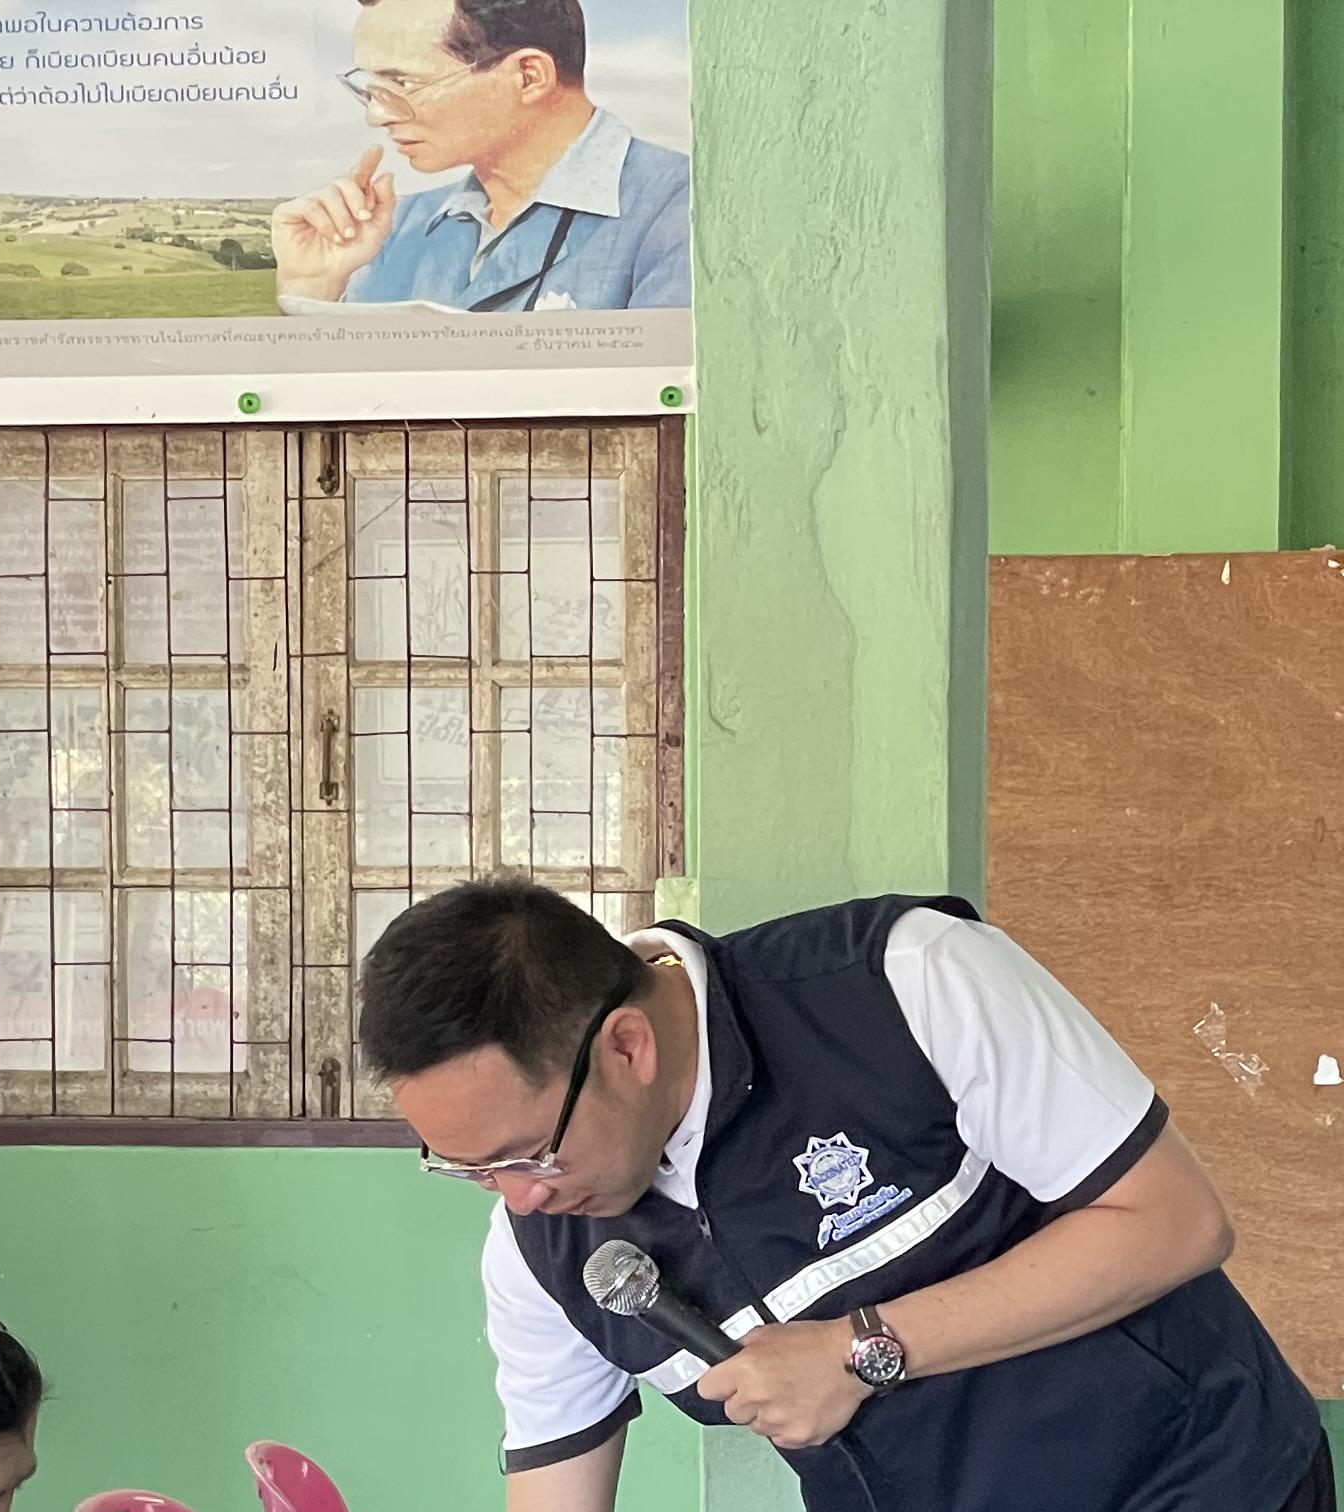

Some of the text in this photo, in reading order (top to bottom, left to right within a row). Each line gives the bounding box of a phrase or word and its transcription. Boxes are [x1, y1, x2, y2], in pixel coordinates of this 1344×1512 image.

[25, 41, 267, 70] ก็เบียดเบียนคนอื่นน้อย
